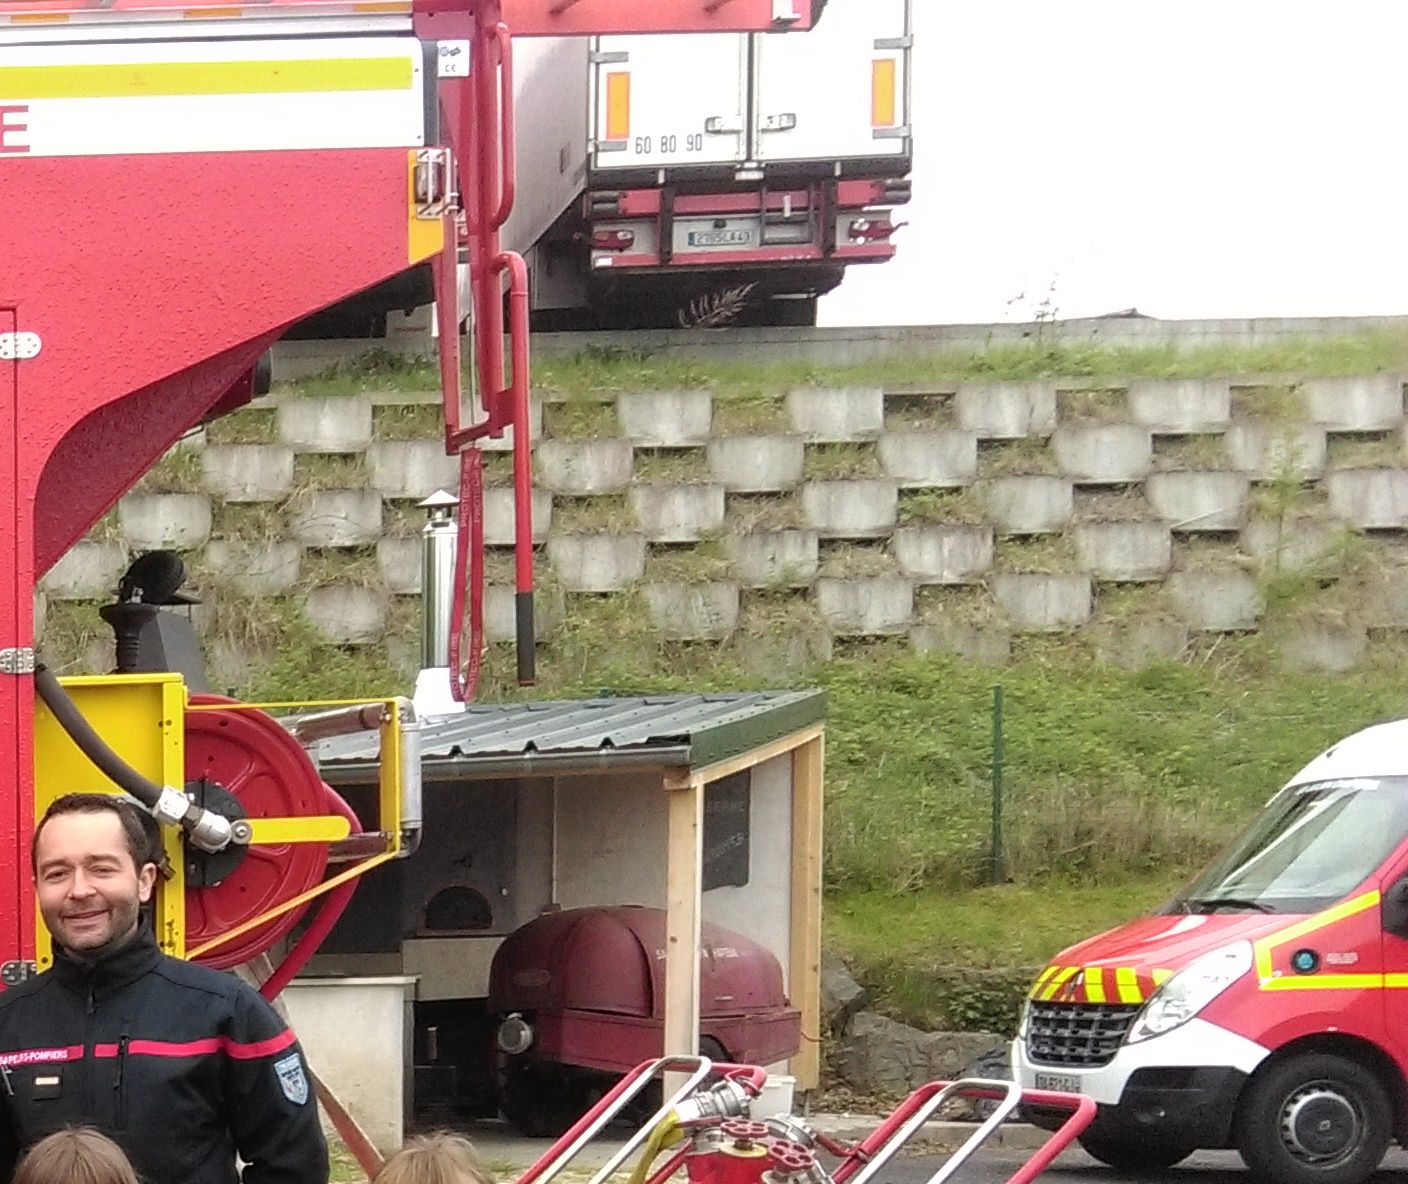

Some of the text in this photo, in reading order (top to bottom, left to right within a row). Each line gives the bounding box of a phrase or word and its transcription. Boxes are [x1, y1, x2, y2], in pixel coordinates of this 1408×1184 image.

[635, 133, 703, 154] 60 80 90
